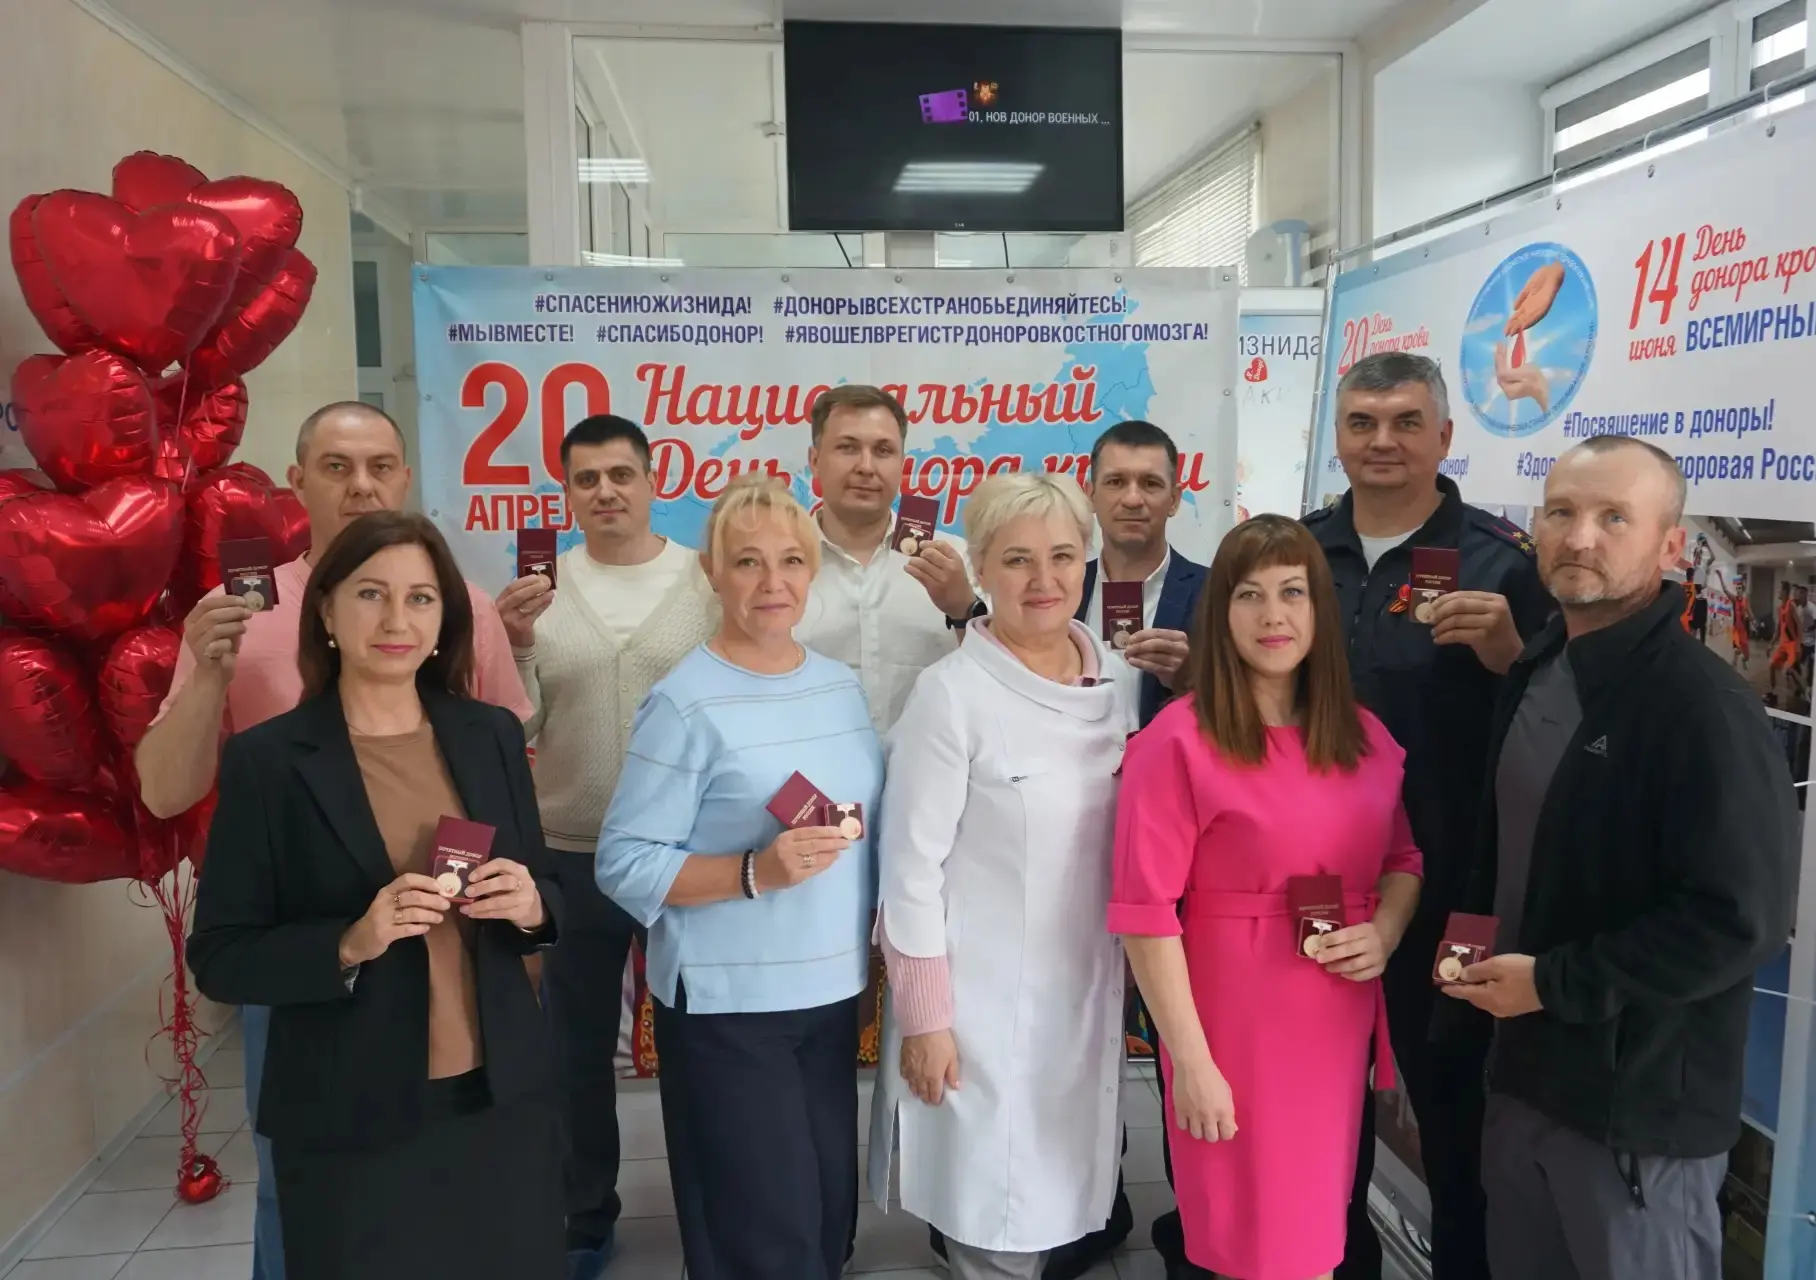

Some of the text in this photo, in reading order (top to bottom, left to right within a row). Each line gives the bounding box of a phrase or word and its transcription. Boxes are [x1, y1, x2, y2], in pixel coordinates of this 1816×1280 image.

[968, 111, 983, 123] 01.
[986, 111, 1007, 122] НОВ
[1009, 111, 1046, 124] ДОНОР
[1048, 112, 1098, 124] ВОЕННЫХ
[1692, 224, 1747, 261] День
[1628, 232, 1686, 330] 14
[1689, 256, 1770, 311] донора
[535, 294, 752, 317] #СПАСЕНИЮЖИЗНИДА!
[448, 323, 1208, 347] #МЫВМЕСТЕ! #СПАСИБОДОНОР! #ЯВОШЕЛВРЕГИСТРДОНОРОВКОСТНОГОМОЗГА!
[1371, 313, 1393, 336] День
[1401, 326, 1430, 352] крови
[1685, 301, 1816, 352] ВСЕМИРНЫ
[1337, 316, 1369, 375] 20
[1628, 335, 1677, 362] июня
[636, 363, 1102, 441] Нациоальный
[1563, 398, 1775, 440] #Посвящение в доноры!
[461, 362, 611, 487] 20
[1761, 447, 1816, 482] Росс
